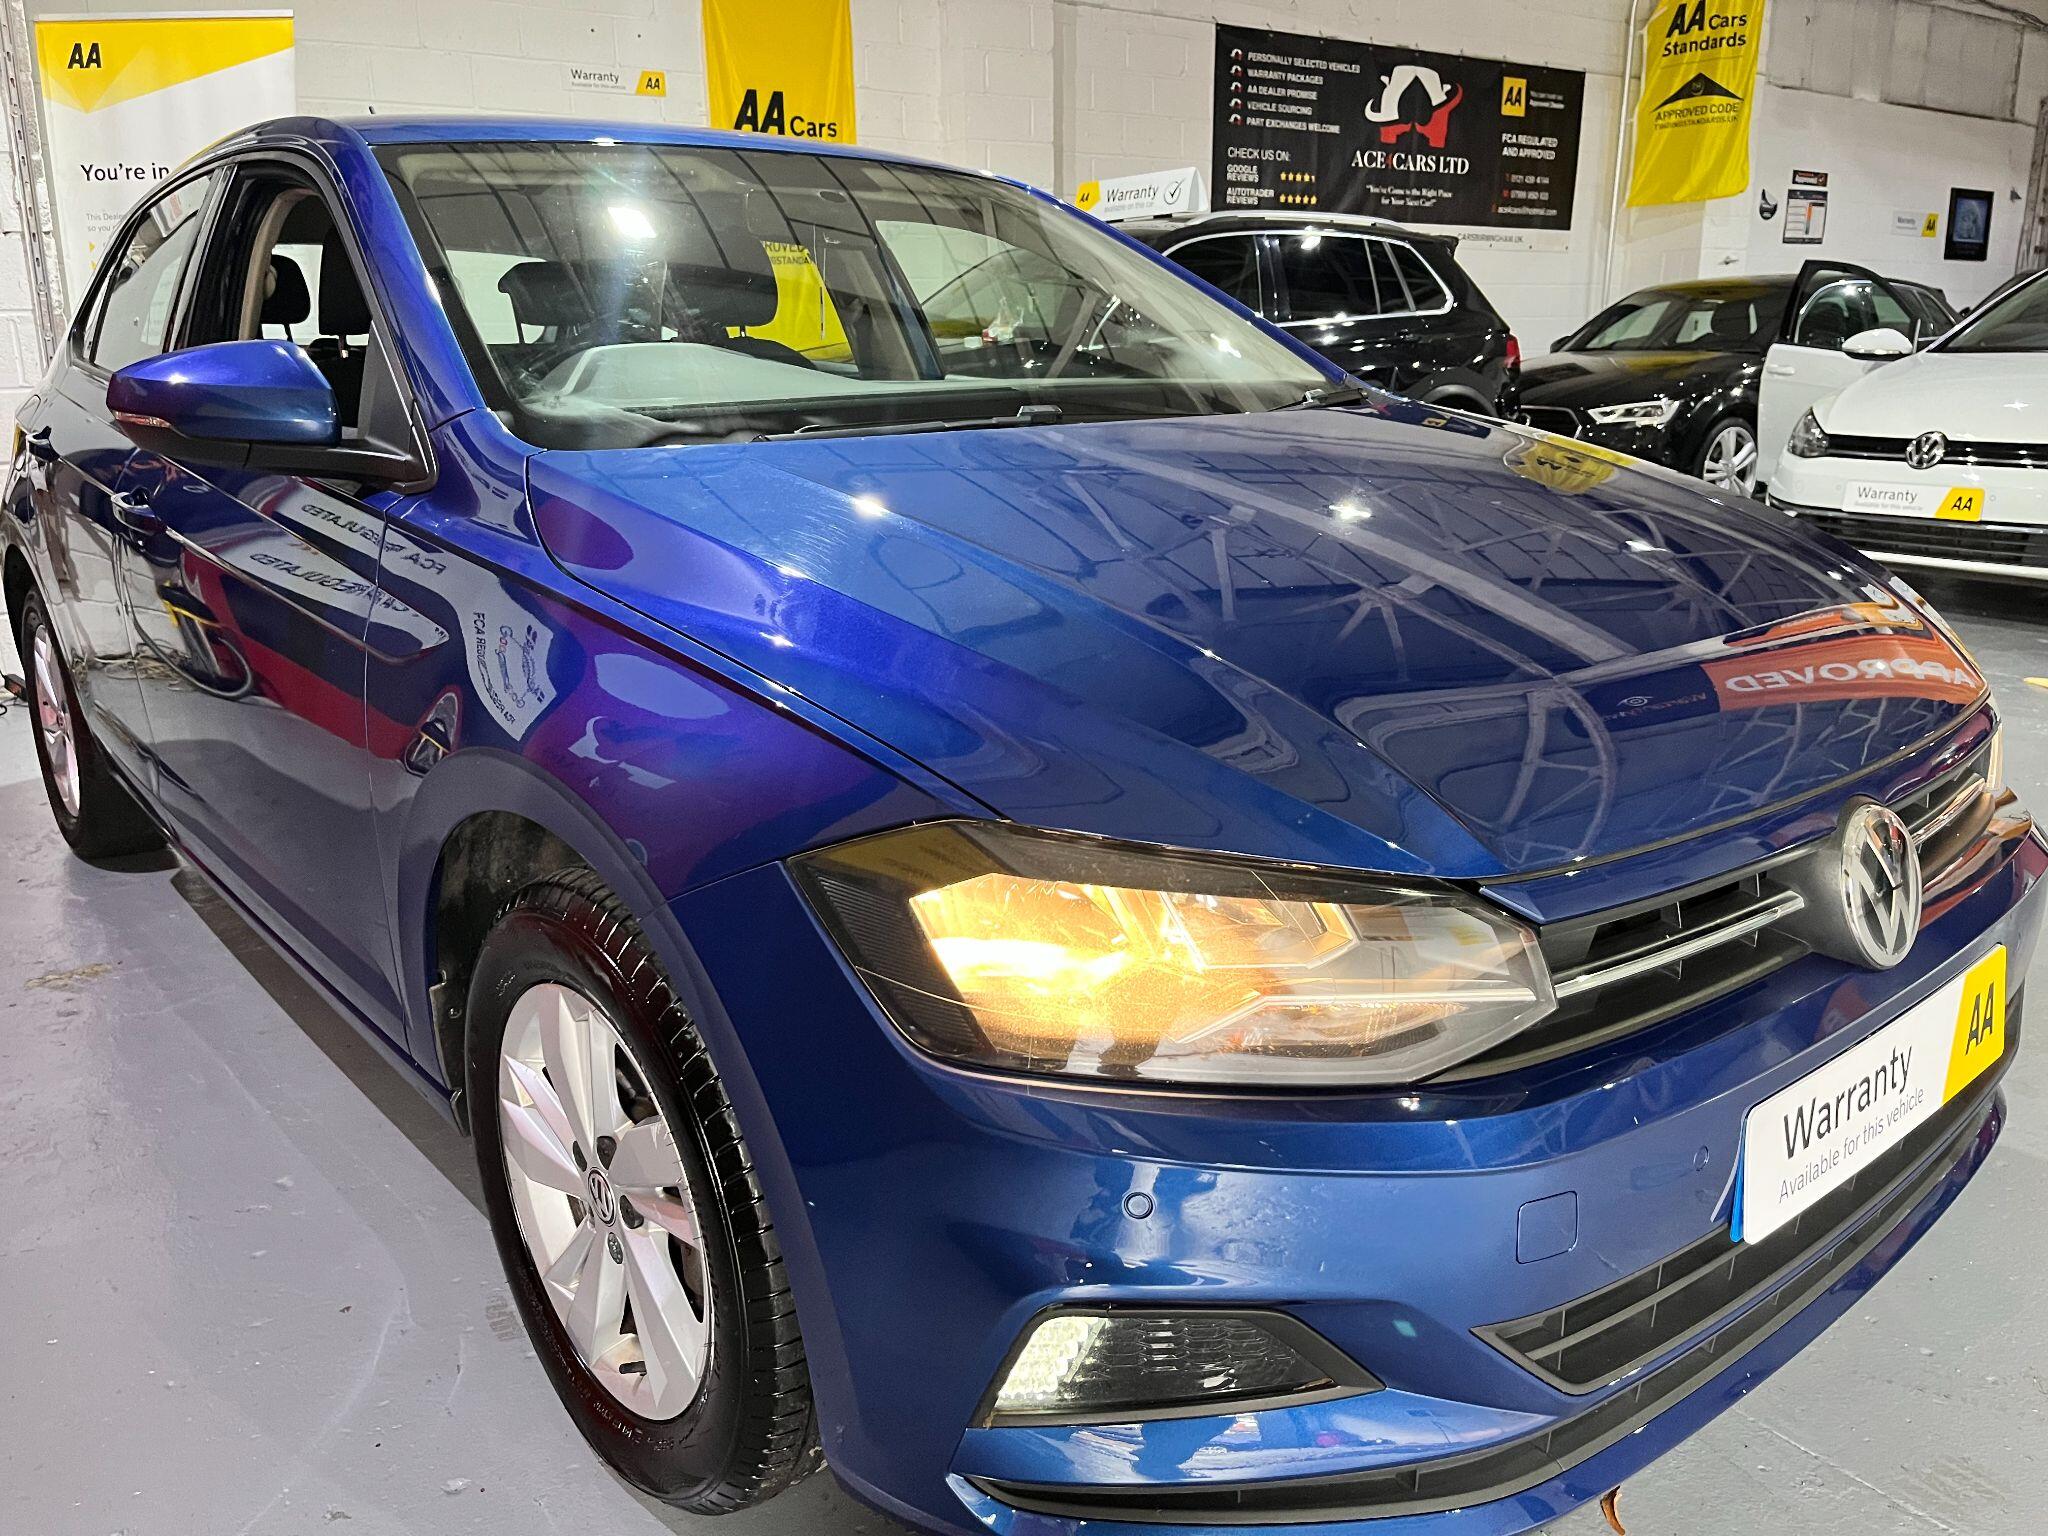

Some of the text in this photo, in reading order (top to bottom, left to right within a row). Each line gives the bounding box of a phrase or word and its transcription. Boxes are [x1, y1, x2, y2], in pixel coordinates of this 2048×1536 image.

[1666, 0, 1747, 38] AA Cars
[1662, 32, 1746, 57] Standards
[67, 43, 102, 69] AA
[1248, 52, 1360, 74] PERSONALLY SELECTED VEHICLES
[571, 68, 660, 90] Warranty AA
[1247, 68, 1324, 85] WARRANTY PACKAGES
[1248, 85, 1317, 100] AA DEALER PROMISE
[1504, 86, 1522, 106] AA
[734, 89, 837, 138] AA Cars
[1247, 101, 1312, 115] VEHICLE SOURCING
[1655, 102, 1738, 121] APPROVED CODE
[1246, 117, 1340, 134] PART EXCHANGES WELCOME
[1502, 133, 1558, 148] FCA REGULATED
[1228, 146, 1260, 159] CHECK
[1261, 150, 1274, 160] US
[1502, 146, 1556, 160] AND APPROVED
[1226, 164, 1258, 173] GOOGLE
[1439, 156, 1470, 174] LTD
[1226, 173, 1259, 182] REVIEWS
[1106, 184, 1160, 203] Warranty
[1226, 187, 1274, 197] AUTOTRADER
[1226, 196, 1258, 205] REVIEWS
[1858, 486, 1973, 511] Warranty AA
[1783, 980, 1994, 1160] Warranty AA
[1778, 1087, 1924, 1204] Available for this vehicle
